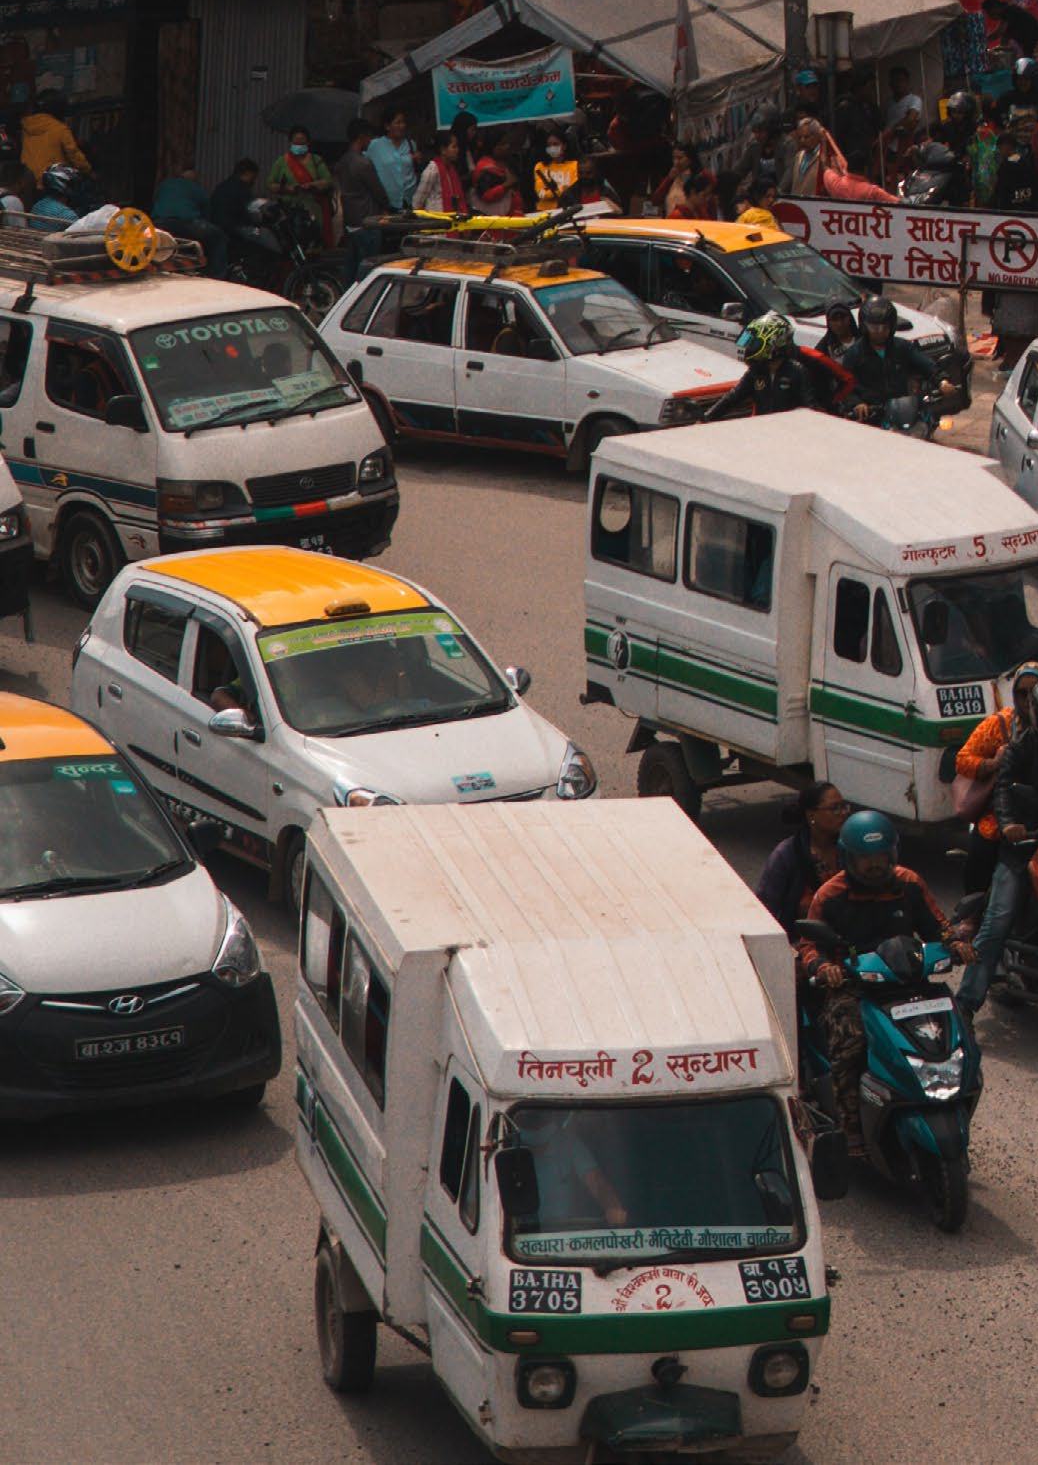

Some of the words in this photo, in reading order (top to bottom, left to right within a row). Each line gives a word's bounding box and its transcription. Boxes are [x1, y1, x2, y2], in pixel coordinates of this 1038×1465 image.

[819, 206, 894, 239] सवारी
[905, 215, 981, 245] साधन
[174, 318, 273, 345] TOYOTA
[972, 535, 987, 558] 5
[517, 1051, 617, 1088] तिनचुली
[666, 1047, 759, 1082] सुन्धारा
[512, 1289, 579, 1312] 3705
